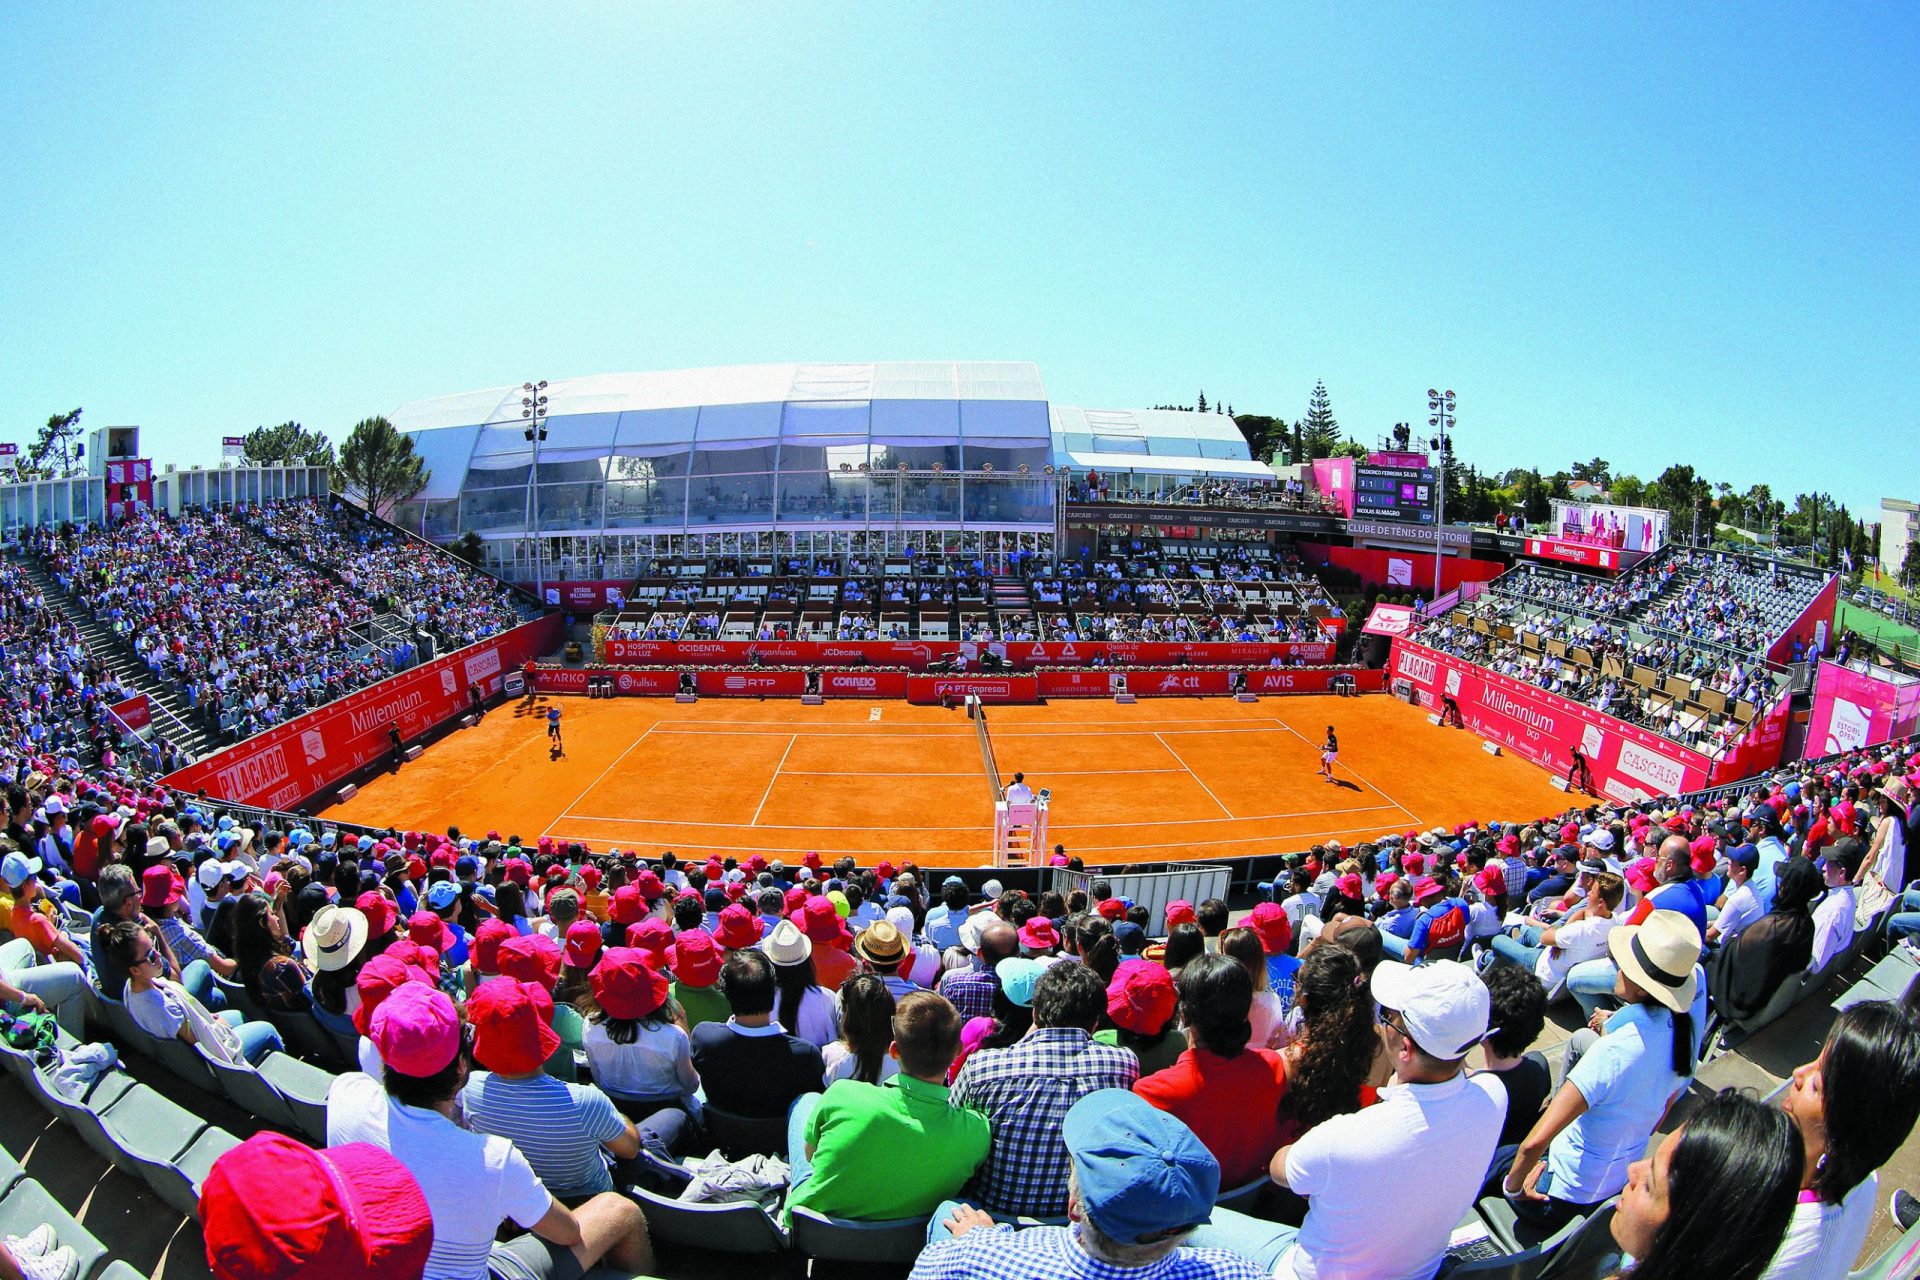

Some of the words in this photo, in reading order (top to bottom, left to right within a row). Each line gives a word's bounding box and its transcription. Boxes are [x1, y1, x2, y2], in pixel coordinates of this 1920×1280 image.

[1348, 523, 1375, 534] CLUBE
[1378, 526, 1389, 535] DE
[1391, 526, 1416, 538] TÉNIS
[1418, 530, 1432, 539] DO
[1554, 544, 1585, 557] Millennium
[467, 655, 498, 677] CASCAIS
[1400, 653, 1436, 682] PLACARD
[554, 673, 585, 682] ARKO
[633, 677, 657, 687] fullsix
[832, 677, 876, 687] CORREIO
[1183, 676, 1199, 687] ctt
[1264, 675, 1294, 687] AVIS
[968, 685, 1006, 694] Empresas
[349, 690, 422, 736] Millennium
[1482, 682, 1554, 732] Millennium
[404, 712, 416, 723] bcp
[1526, 727, 1540, 740] bcp
[1836, 722, 1861, 737] ESTORIL
[1839, 730, 1855, 741] OPEN
[1506, 730, 1514, 746] M
[353, 752, 364, 766] M
[1542, 748, 1552, 764] M
[220, 749, 287, 800] PLACARD
[1623, 750, 1679, 786] CASCAIS
[312, 773, 324, 789] M
[269, 783, 299, 808] PLACARD
